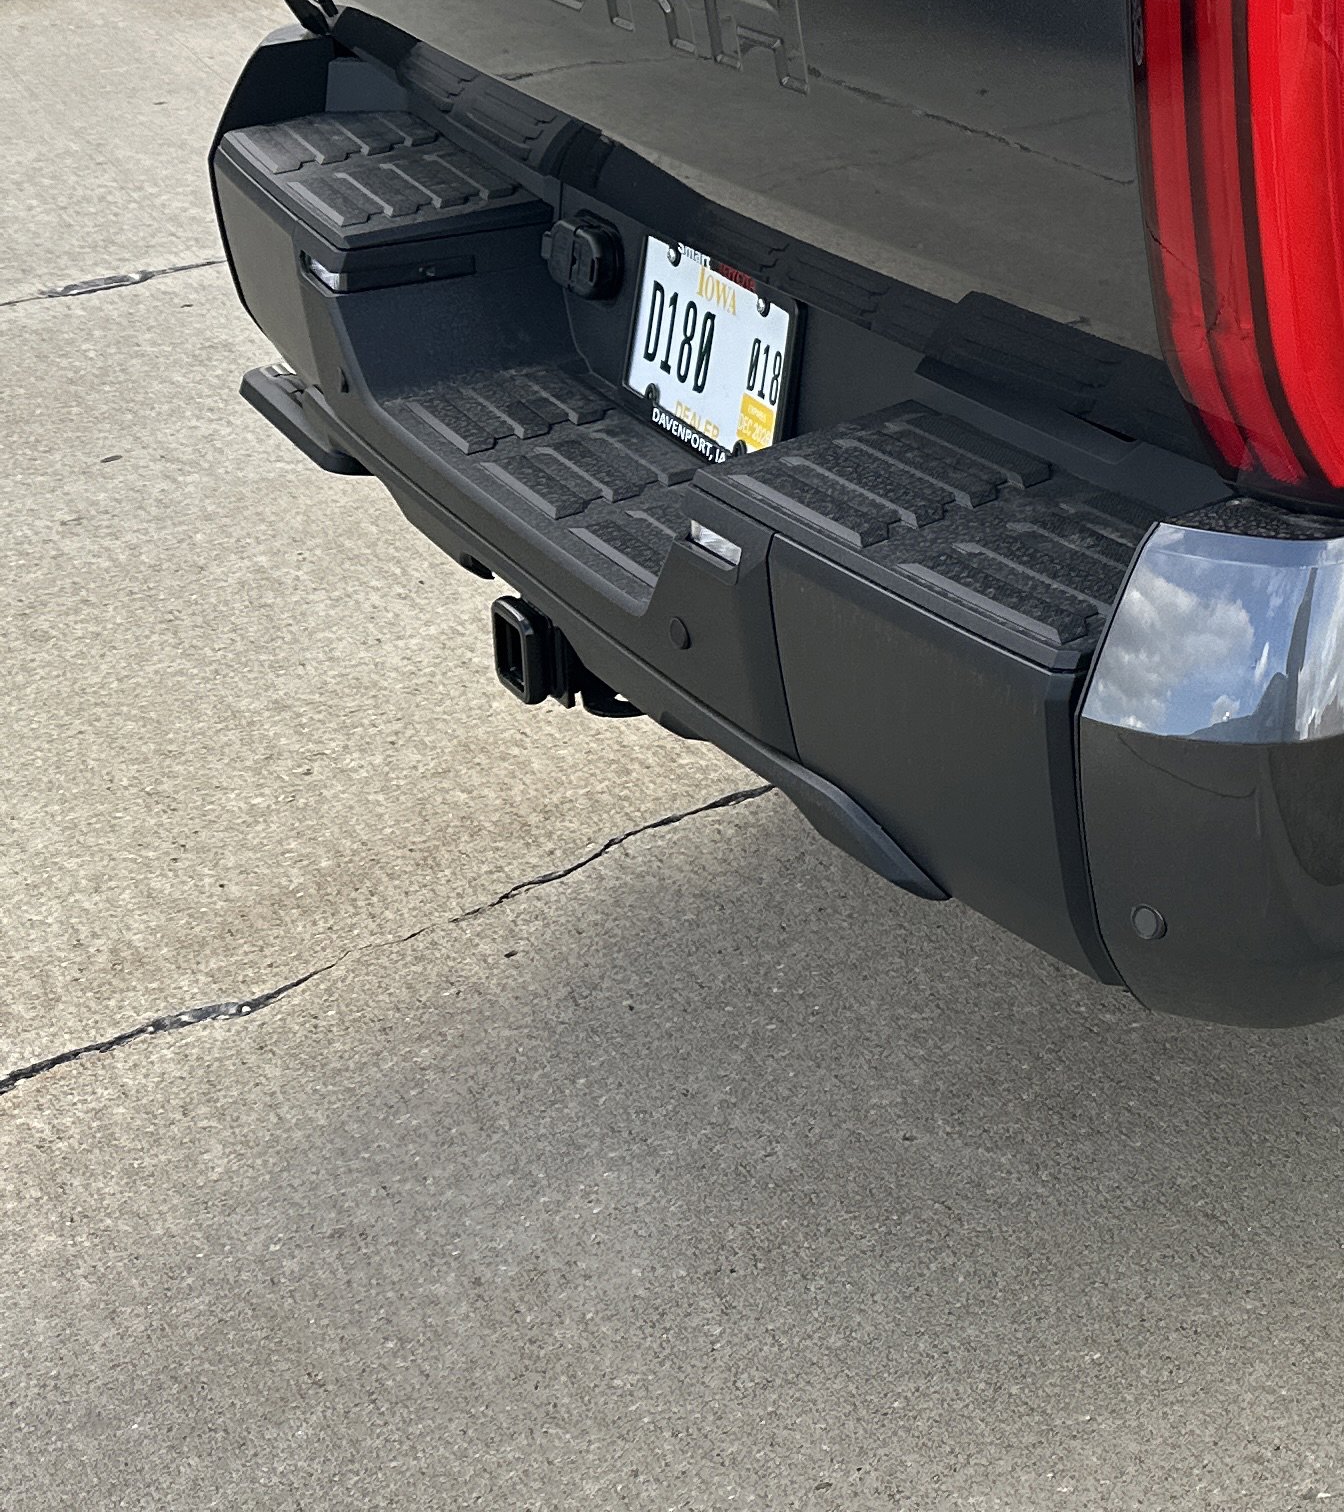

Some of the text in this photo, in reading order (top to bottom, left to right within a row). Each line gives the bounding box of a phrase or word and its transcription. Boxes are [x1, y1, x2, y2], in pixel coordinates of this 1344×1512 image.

[643, 279, 783, 406] D180 018
[651, 407, 714, 462] DAVENPORT,
